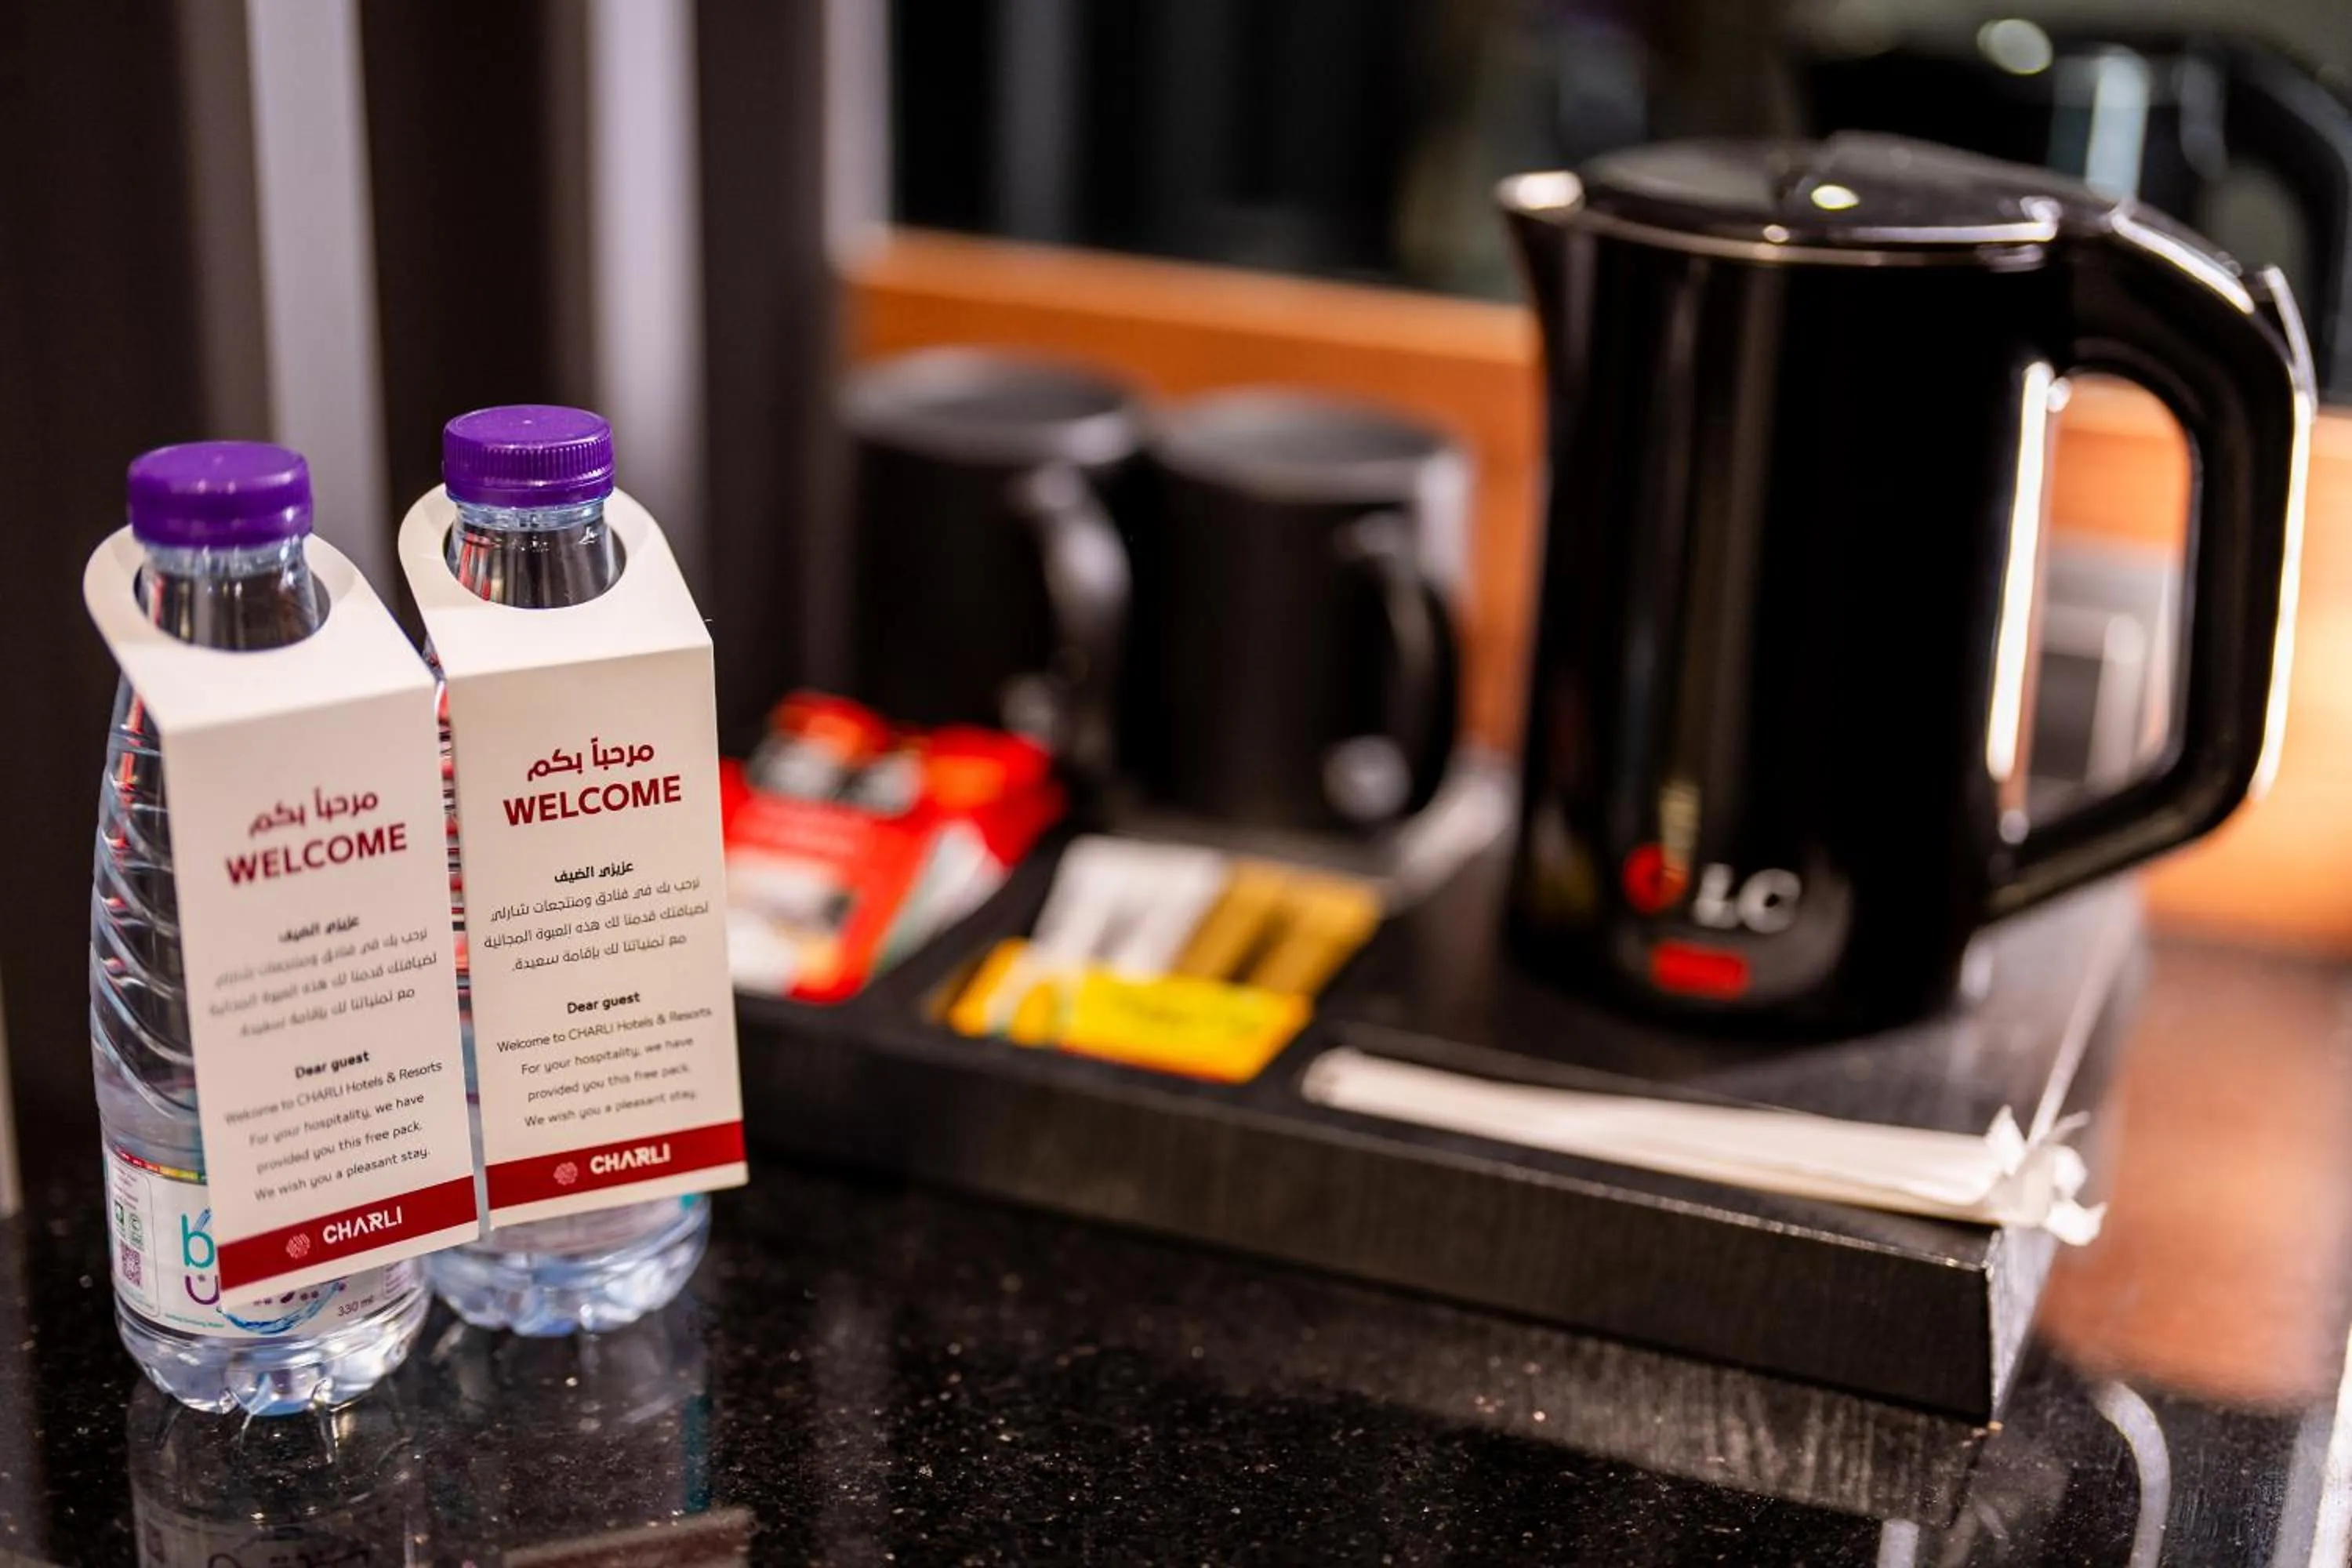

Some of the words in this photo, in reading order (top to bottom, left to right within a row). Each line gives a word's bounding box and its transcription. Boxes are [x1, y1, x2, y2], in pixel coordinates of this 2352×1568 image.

[527, 748, 583, 782] بكم
[503, 775, 681, 826] WELCOME
[249, 801, 306, 839] بكم
[225, 822, 408, 887] WELCOME
[554, 866, 594, 883] الضيف
[533, 896, 591, 912] ومنتجعات
[595, 887, 628, 906] فنادق
[575, 921, 600, 934] هذه
[605, 916, 619, 929] لك
[604, 943, 619, 956] لك
[567, 1000, 598, 1014] Dear
[602, 992, 641, 1010] guest
[497, 1036, 550, 1053] Welcome
[553, 1033, 565, 1044] to
[568, 1023, 614, 1040] CHARLI
[617, 1018, 653, 1032] Hotels
[656, 1013, 666, 1025] &
[295, 1062, 327, 1079] Dear
[331, 1051, 370, 1073] guest
[521, 1063, 540, 1075] For
[544, 1059, 571, 1073] your
[644, 1044, 662, 1053] we
[665, 1038, 693, 1048] have
[281, 1100, 294, 1110] to
[296, 1086, 343, 1106] CHARLI
[346, 1076, 383, 1094] Hotels
[387, 1072, 396, 1084] &
[399, 1062, 443, 1080] Resorts
[528, 1081, 579, 1102] provided
[583, 1080, 604, 1093] you
[608, 1074, 630, 1086] this
[634, 1069, 658, 1080] free
[249, 1133, 268, 1146] For
[274, 1126, 300, 1143] your
[375, 1102, 392, 1114] we
[396, 1094, 424, 1109] have
[524, 1116, 545, 1127] We
[548, 1109, 575, 1123] wish
[579, 1107, 601, 1120] you
[615, 1093, 666, 1112] pleasant
[256, 1149, 310, 1174] provided
[313, 1145, 335, 1161] you
[339, 1138, 361, 1151] this
[365, 1130, 390, 1145] free
[590, 1143, 671, 1174] CHARLI
[254, 1189, 275, 1201] We
[278, 1178, 307, 1195] wish
[310, 1172, 332, 1189] you
[346, 1154, 398, 1178] pleasant
[401, 1148, 430, 1160] stay.
[322, 1206, 402, 1243] CHARLI
[338, 1301, 359, 1317] 330
